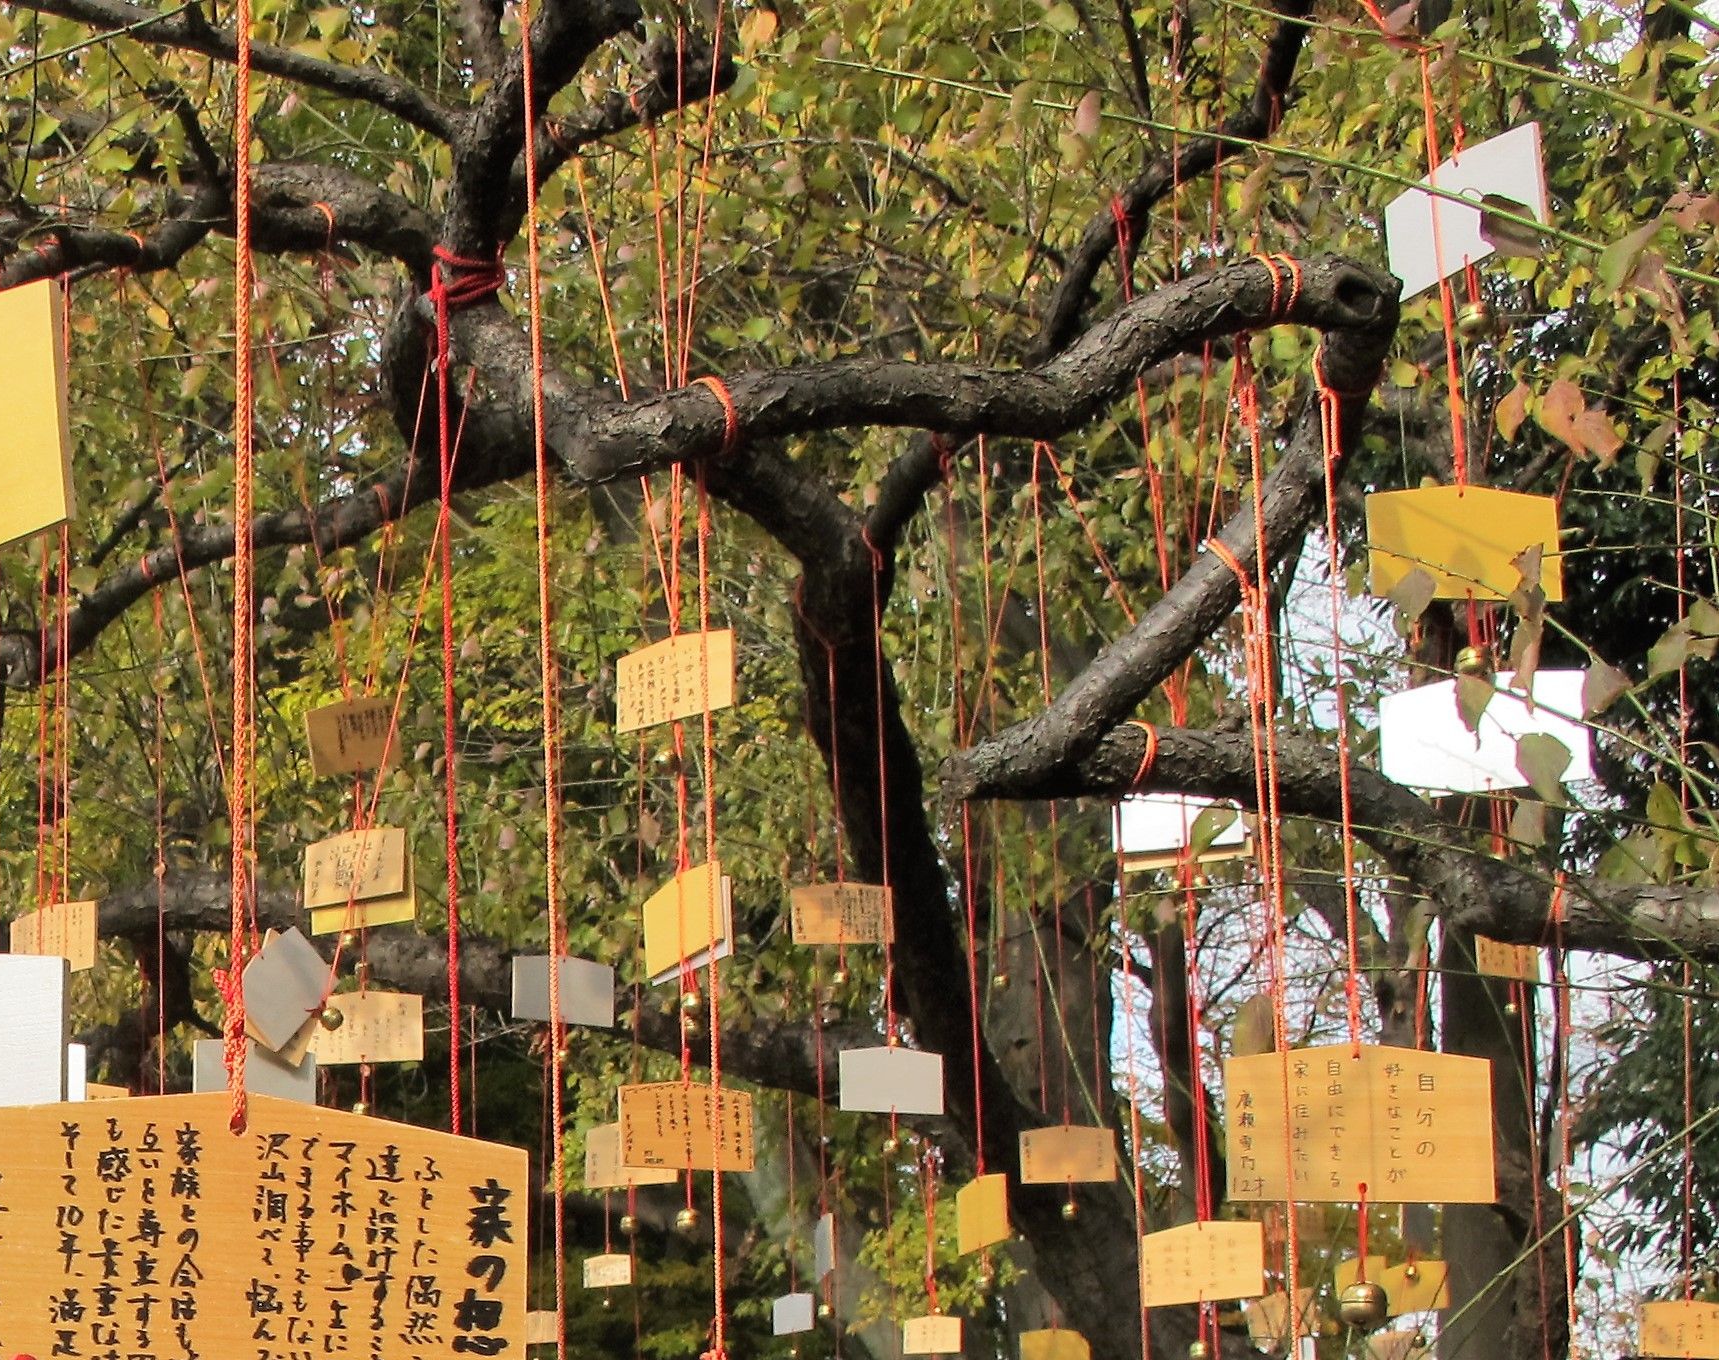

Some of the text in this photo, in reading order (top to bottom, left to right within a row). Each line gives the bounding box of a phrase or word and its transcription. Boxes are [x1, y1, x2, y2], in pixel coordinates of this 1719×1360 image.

[1291, 1059, 1311, 1183] 家に住みたい
[1326, 1059, 1346, 1189] 自由にできる
[1383, 1062, 1407, 1185] 好きなことが
[1415, 1072, 1436, 1158] 自分の
[1232, 1176, 1266, 1198] 12才
